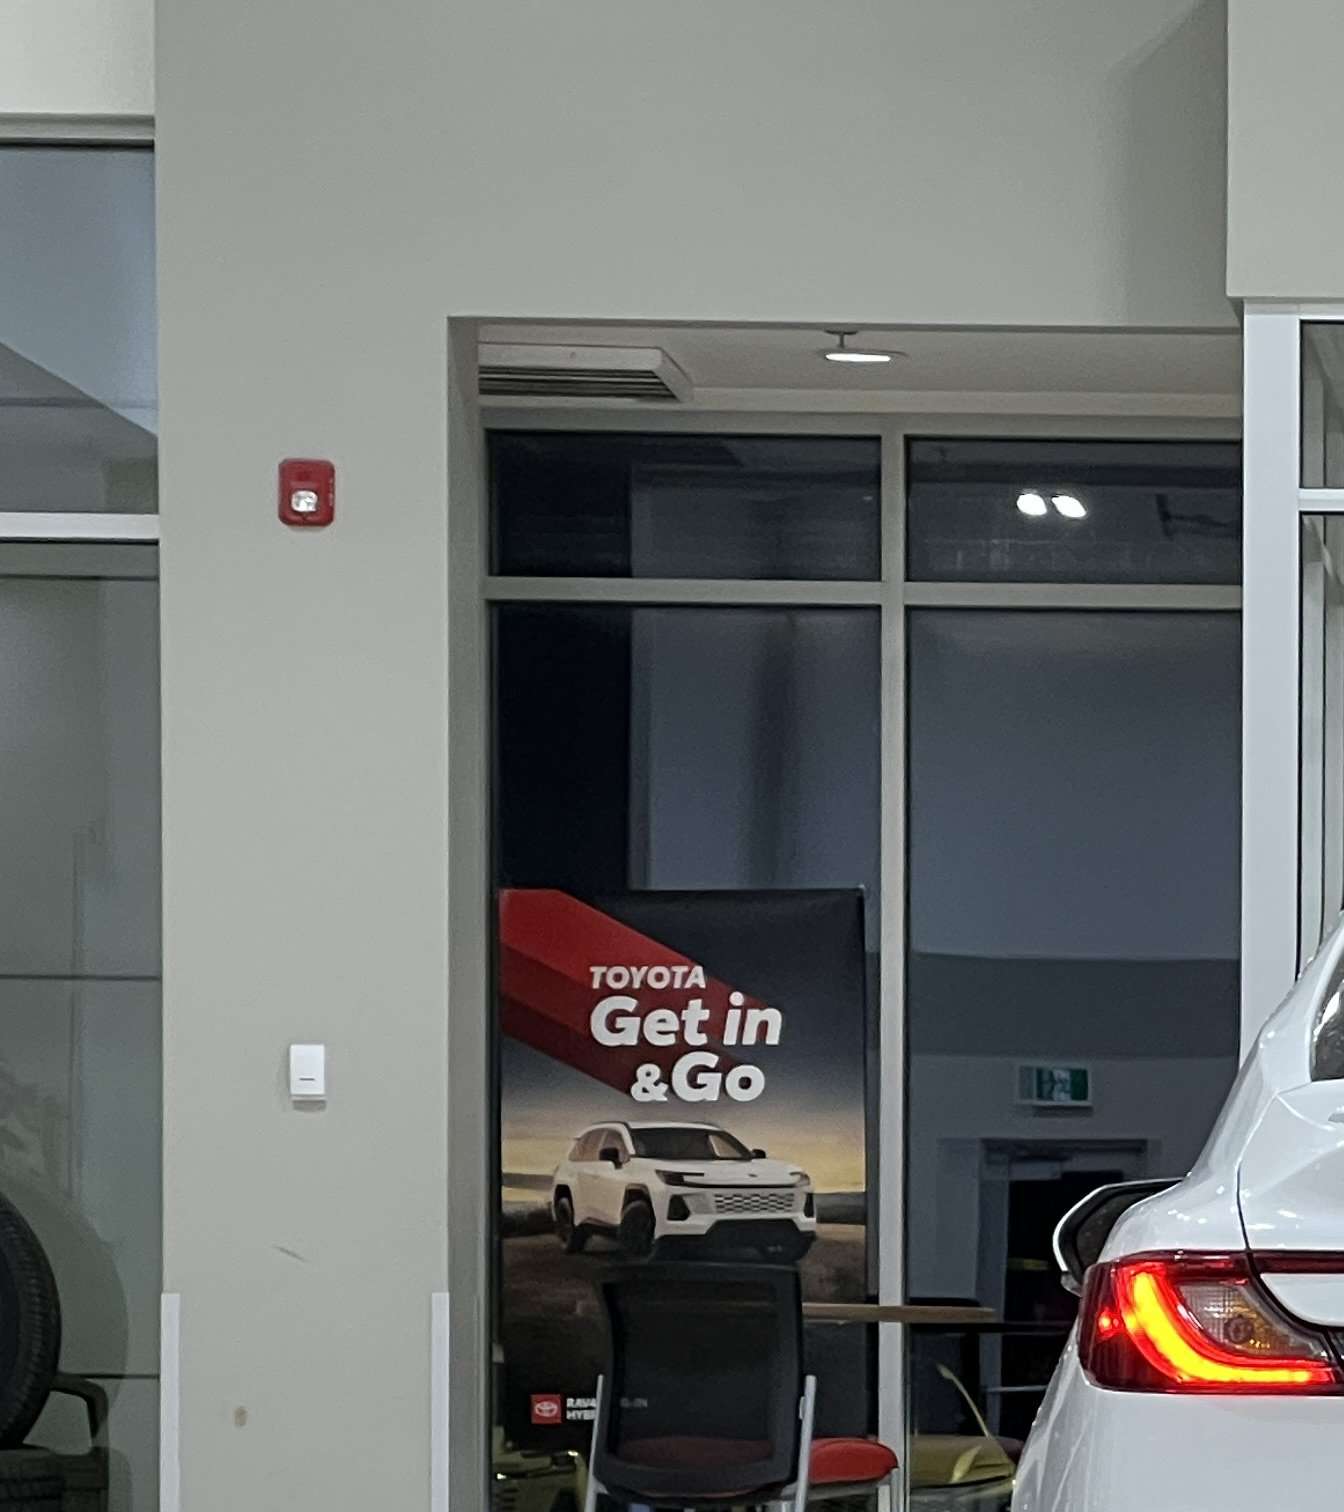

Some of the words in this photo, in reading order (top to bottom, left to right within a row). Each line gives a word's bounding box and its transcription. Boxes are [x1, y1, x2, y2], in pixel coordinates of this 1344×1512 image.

[589, 965, 707, 990] TOYOTA
[589, 994, 711, 1047] Get
[722, 991, 783, 1046] in
[629, 1050, 766, 1103] &Go
